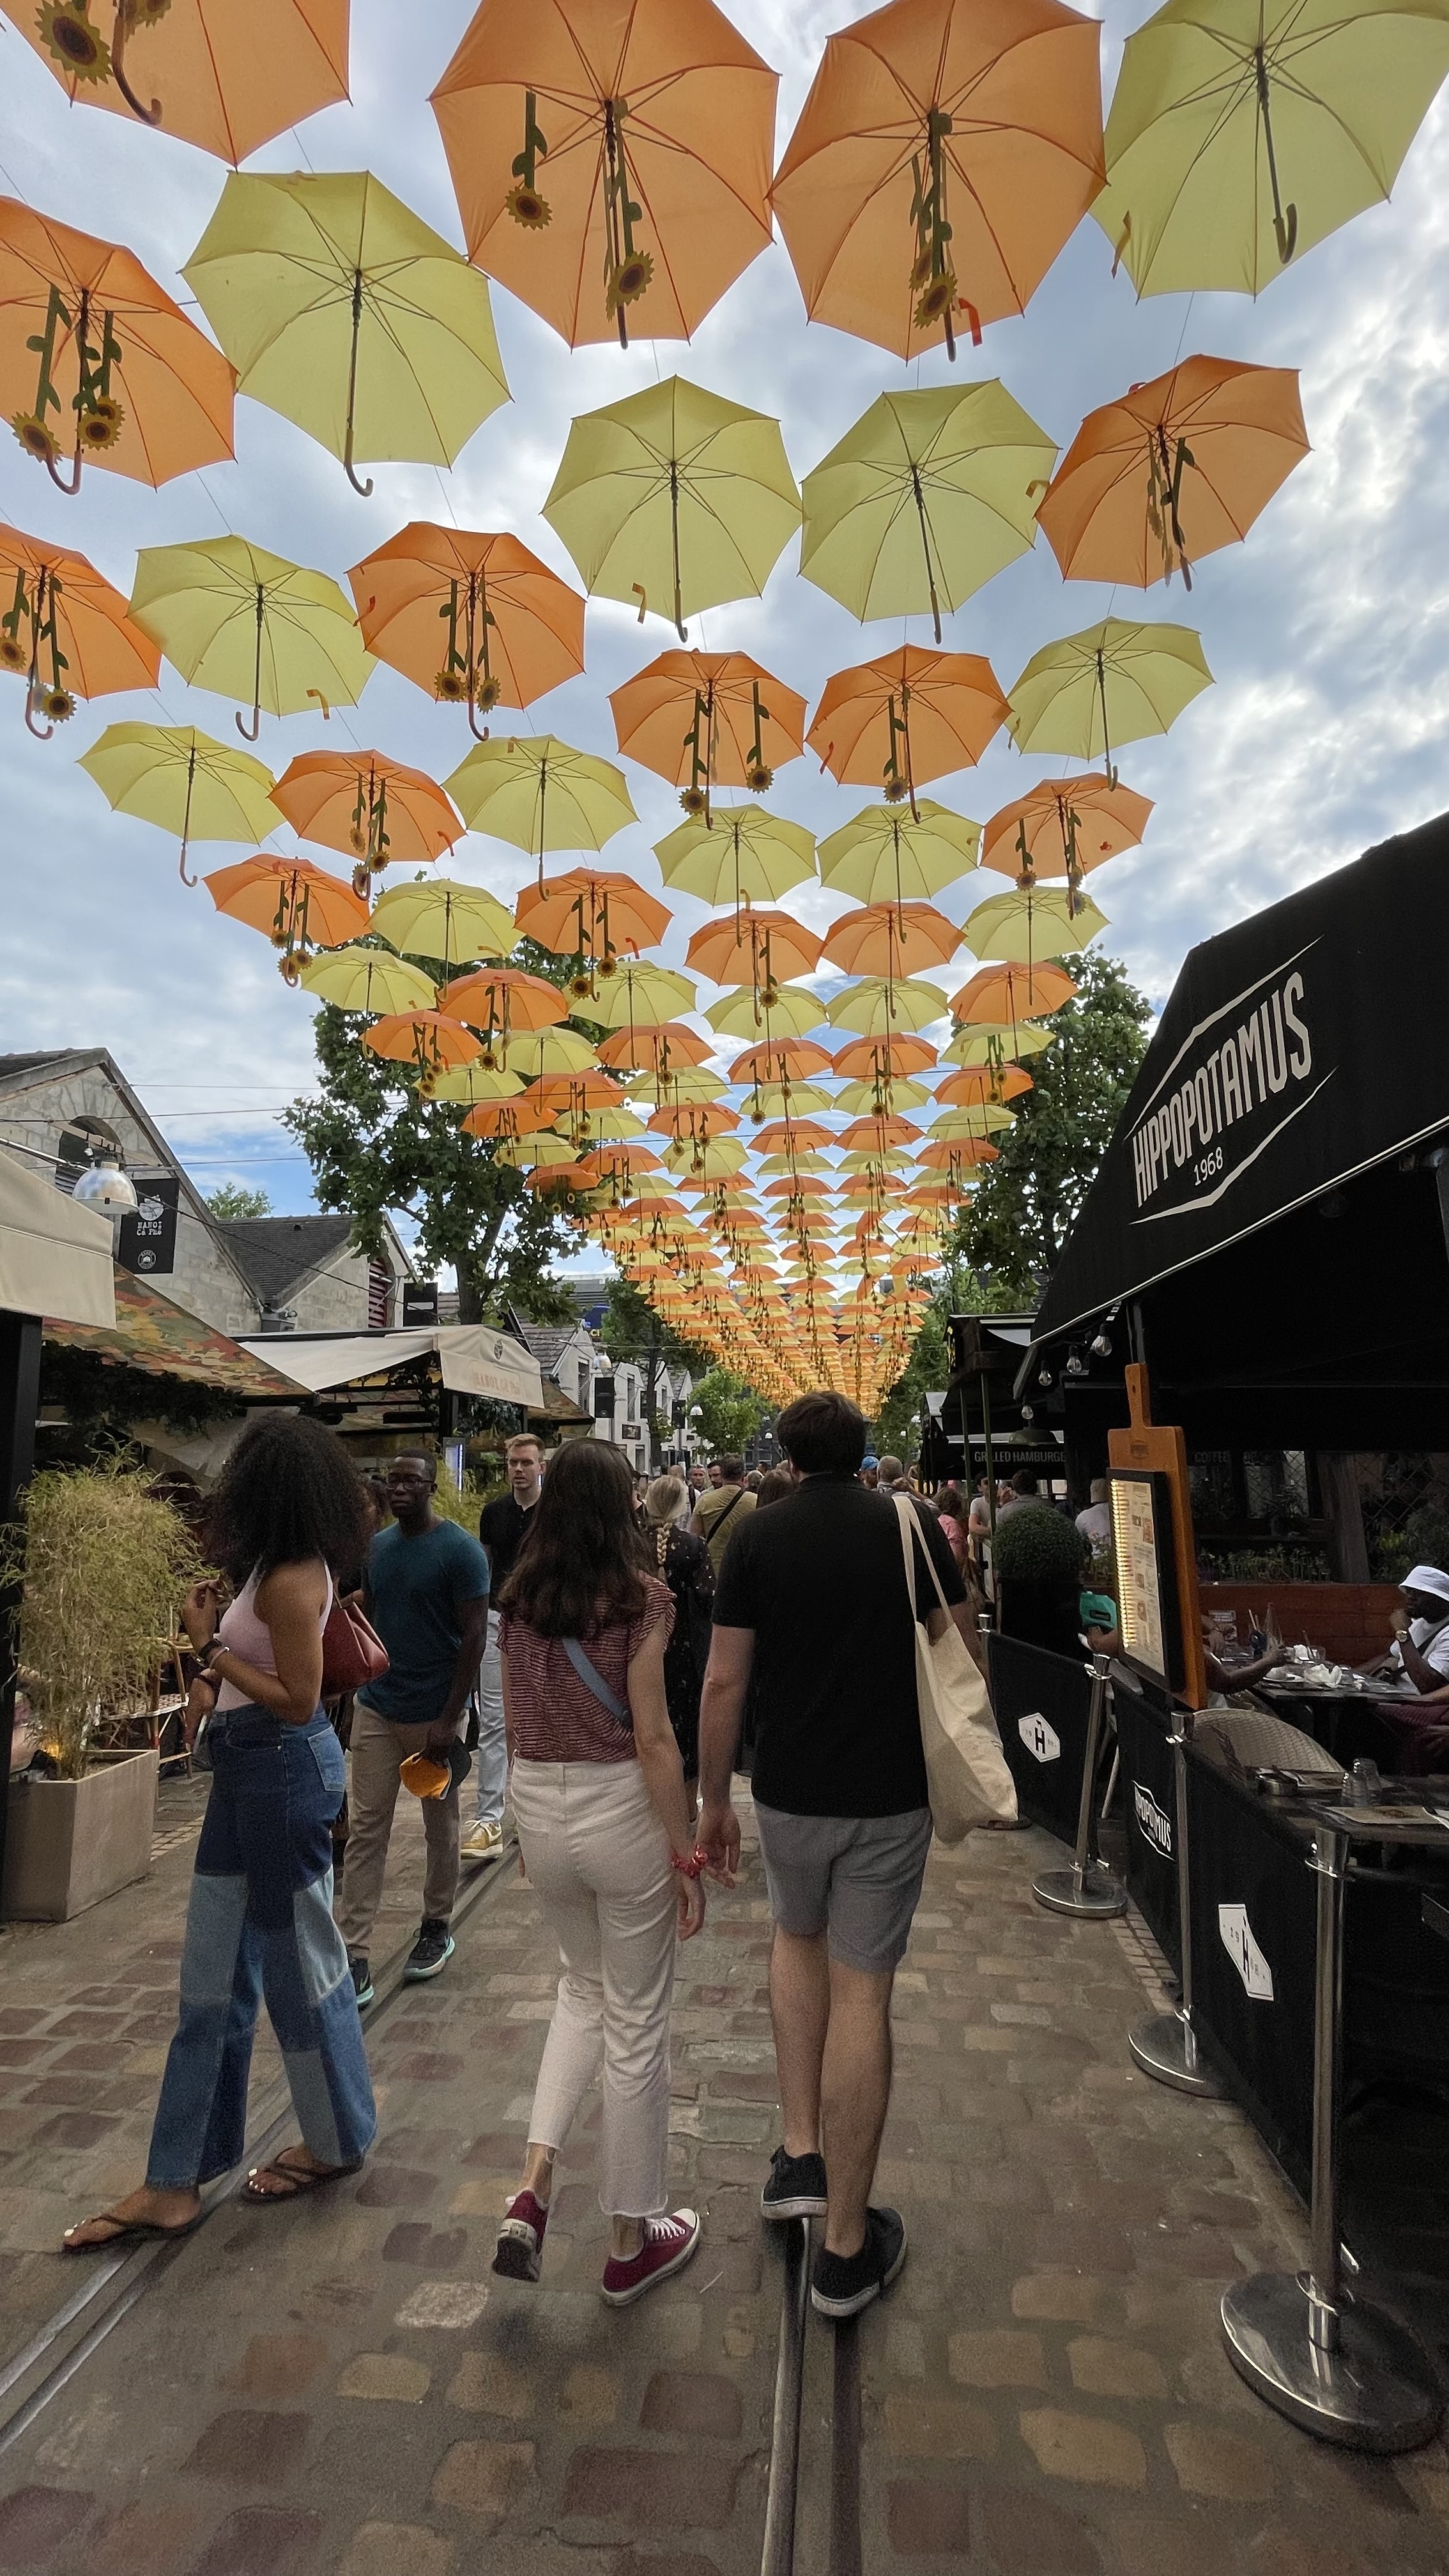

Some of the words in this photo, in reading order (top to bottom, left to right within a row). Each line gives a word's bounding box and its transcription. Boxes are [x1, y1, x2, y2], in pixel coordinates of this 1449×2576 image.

[1132, 971, 1312, 1208] HIPPOPOTAMUS
[1193, 1146, 1224, 1186] 1968
[974, 1451, 1011, 1462] GRLED
[1034, 1727, 1046, 1755] H
